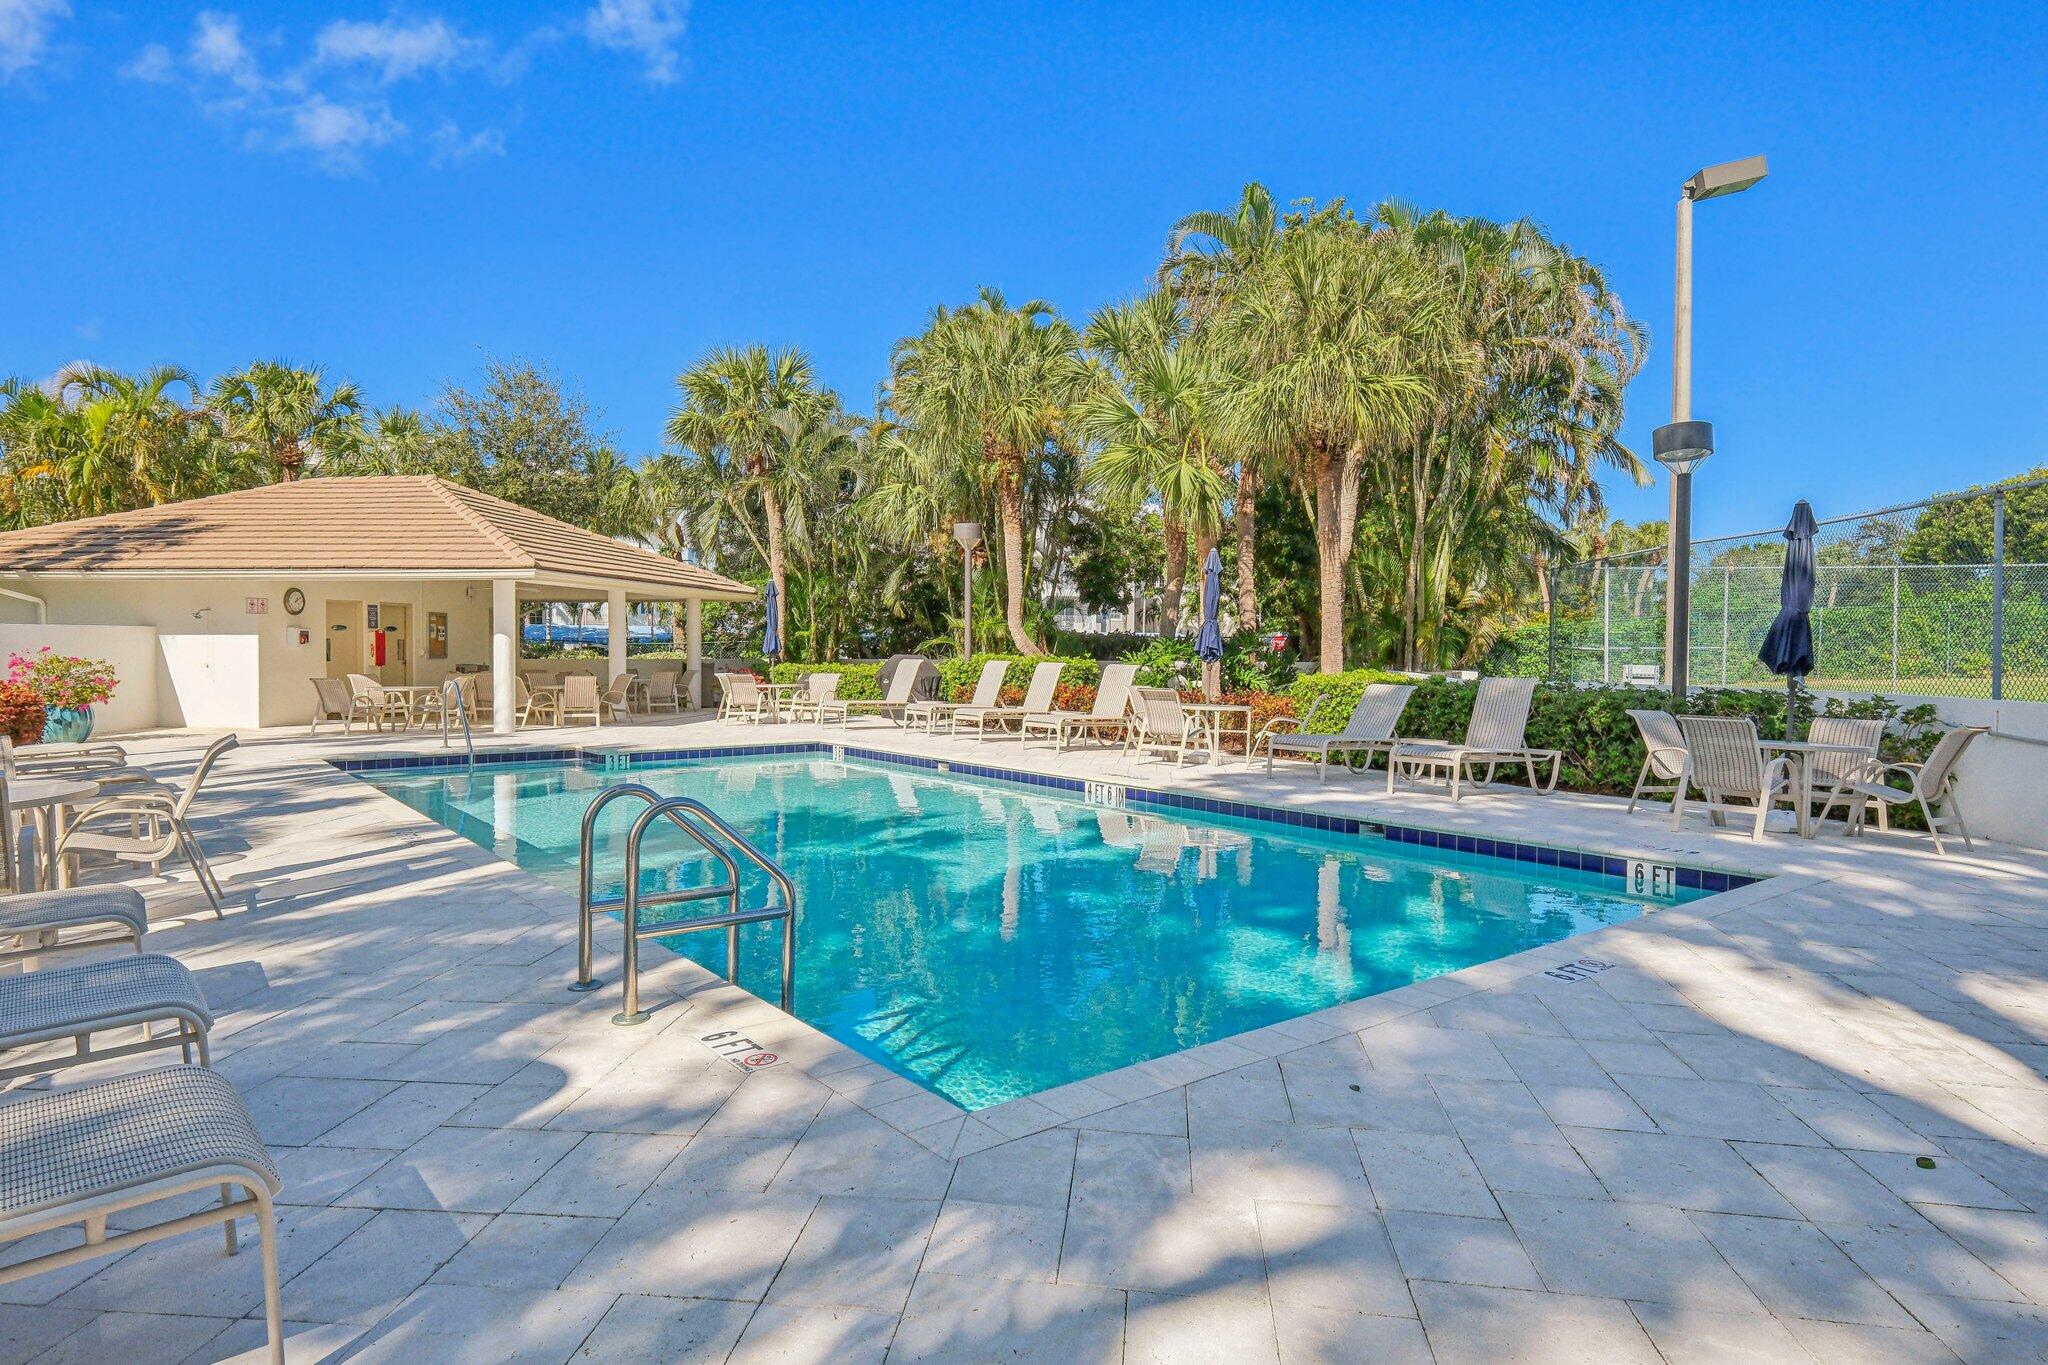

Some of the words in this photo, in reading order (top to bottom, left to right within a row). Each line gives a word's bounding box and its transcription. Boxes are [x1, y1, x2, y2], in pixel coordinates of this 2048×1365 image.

[618, 755, 629, 765] FT
[1095, 784, 1105, 797] FT
[1115, 787, 1125, 800] IN
[1634, 863, 1644, 882] 6
[1652, 865, 1674, 885] FT
[1544, 971, 1576, 981] 6
[1556, 963, 1598, 977] FT
[701, 1030, 738, 1041] 6
[712, 1038, 764, 1056] FT
